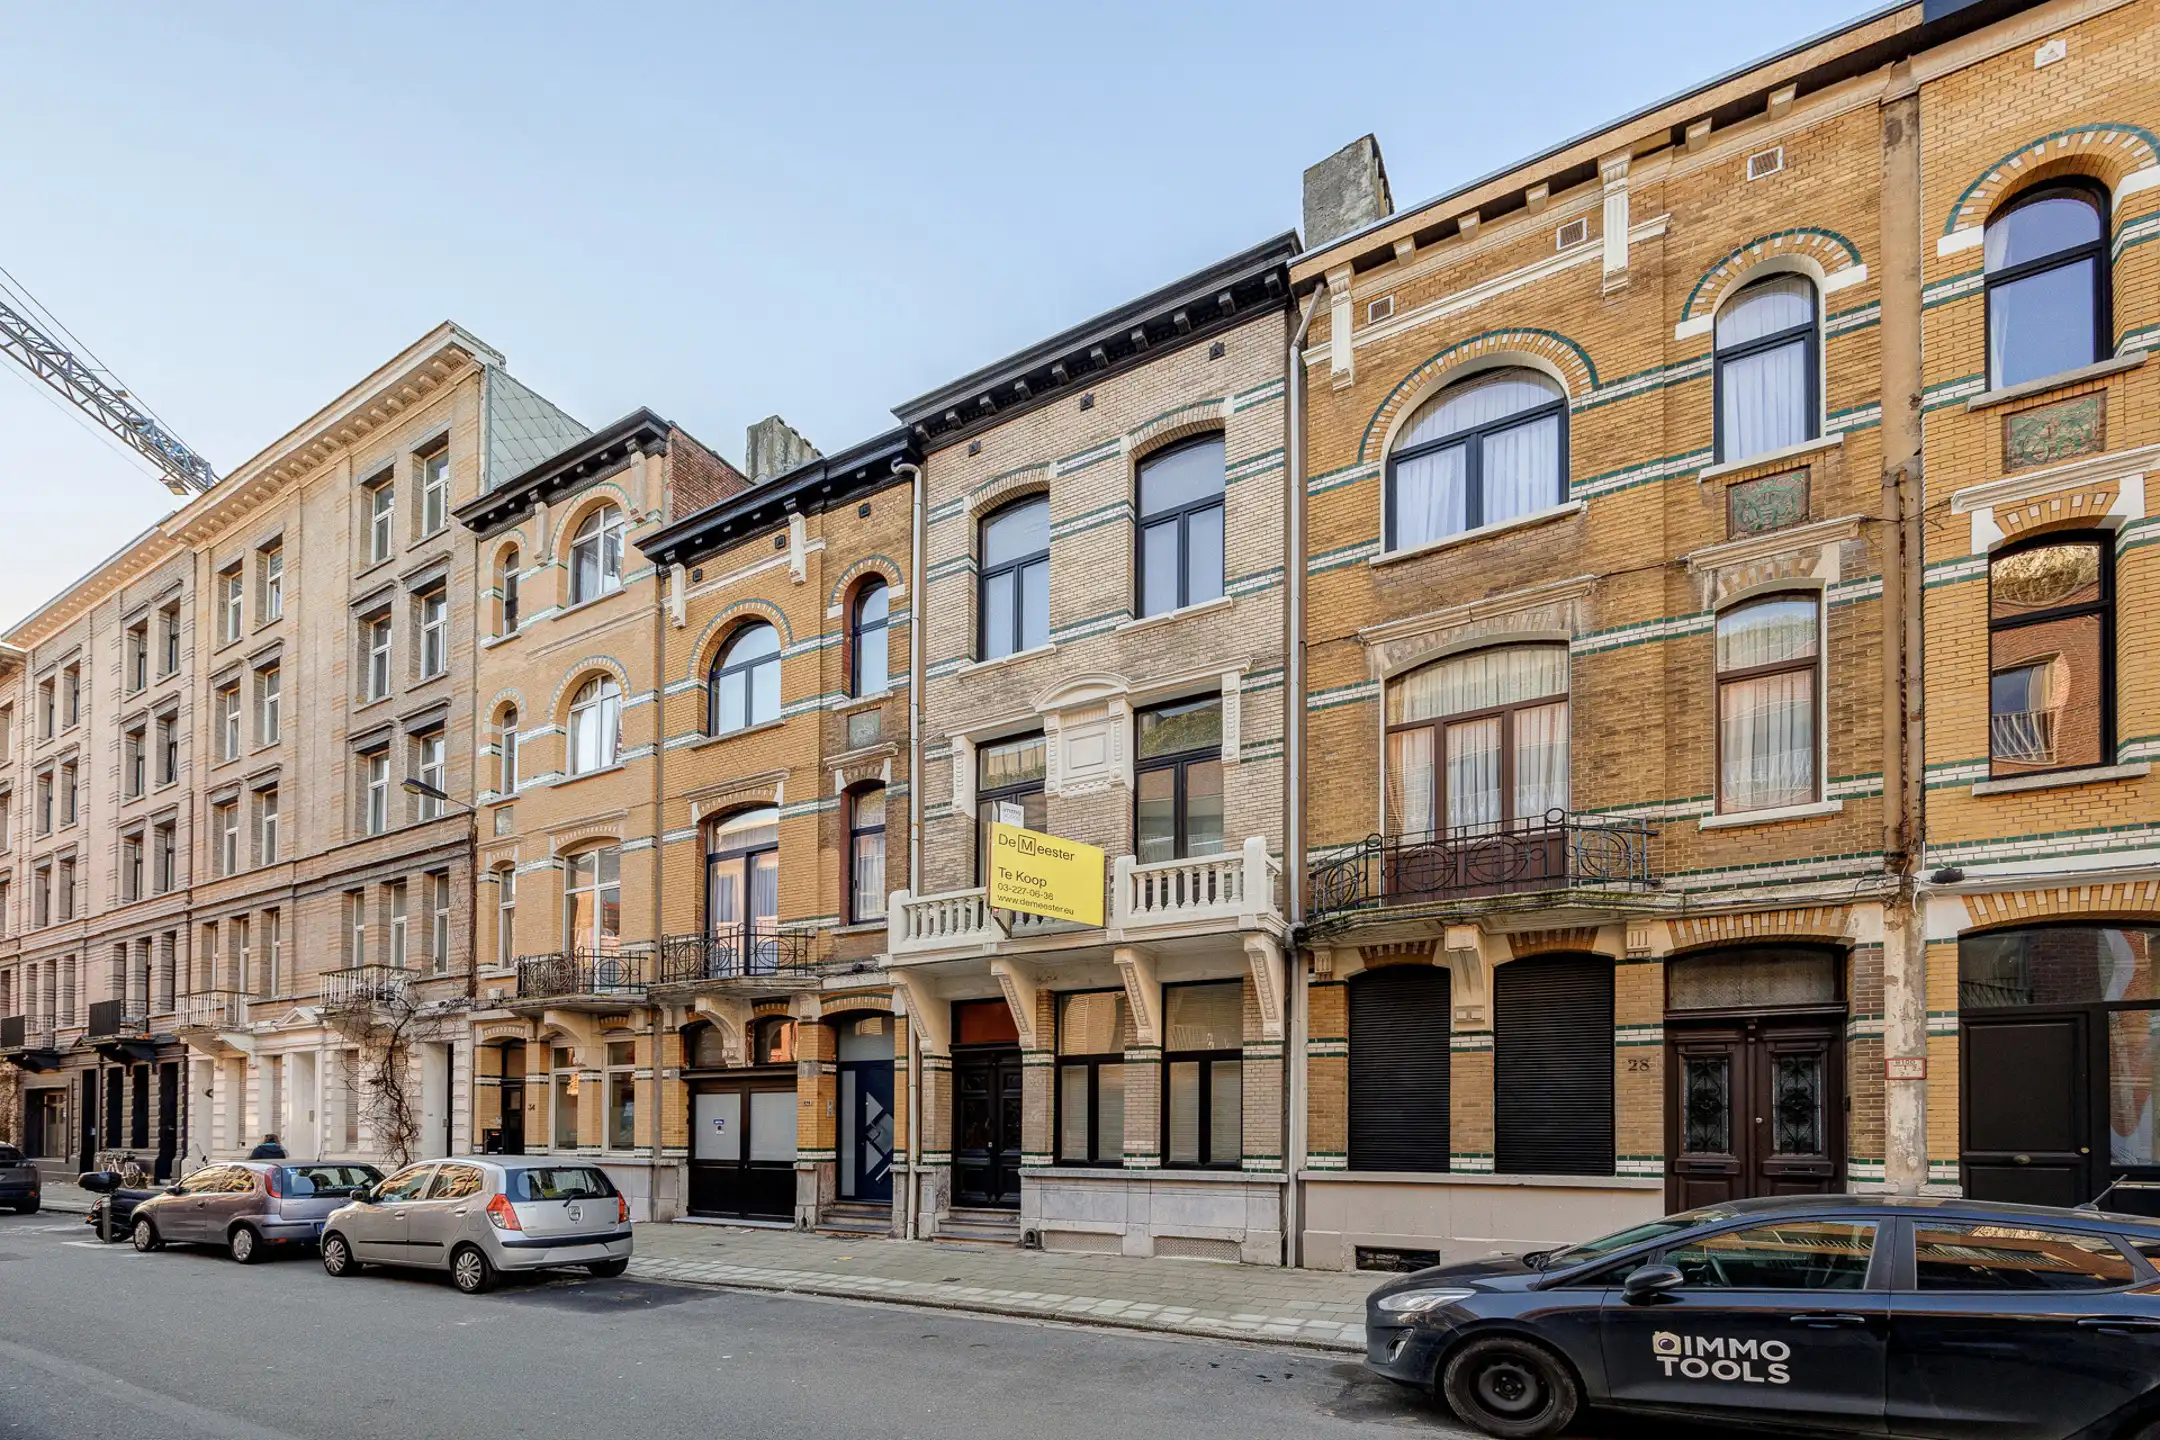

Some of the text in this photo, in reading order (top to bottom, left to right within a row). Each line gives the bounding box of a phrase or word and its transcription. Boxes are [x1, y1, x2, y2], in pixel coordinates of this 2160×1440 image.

[997, 866, 1047, 889] Te Koop
[997, 894, 1075, 915] www.demeester.eu
[1627, 1059, 1650, 1072] 28
[1683, 1335, 1791, 1362] IMMO
[1656, 1355, 1791, 1385] TOOLS
